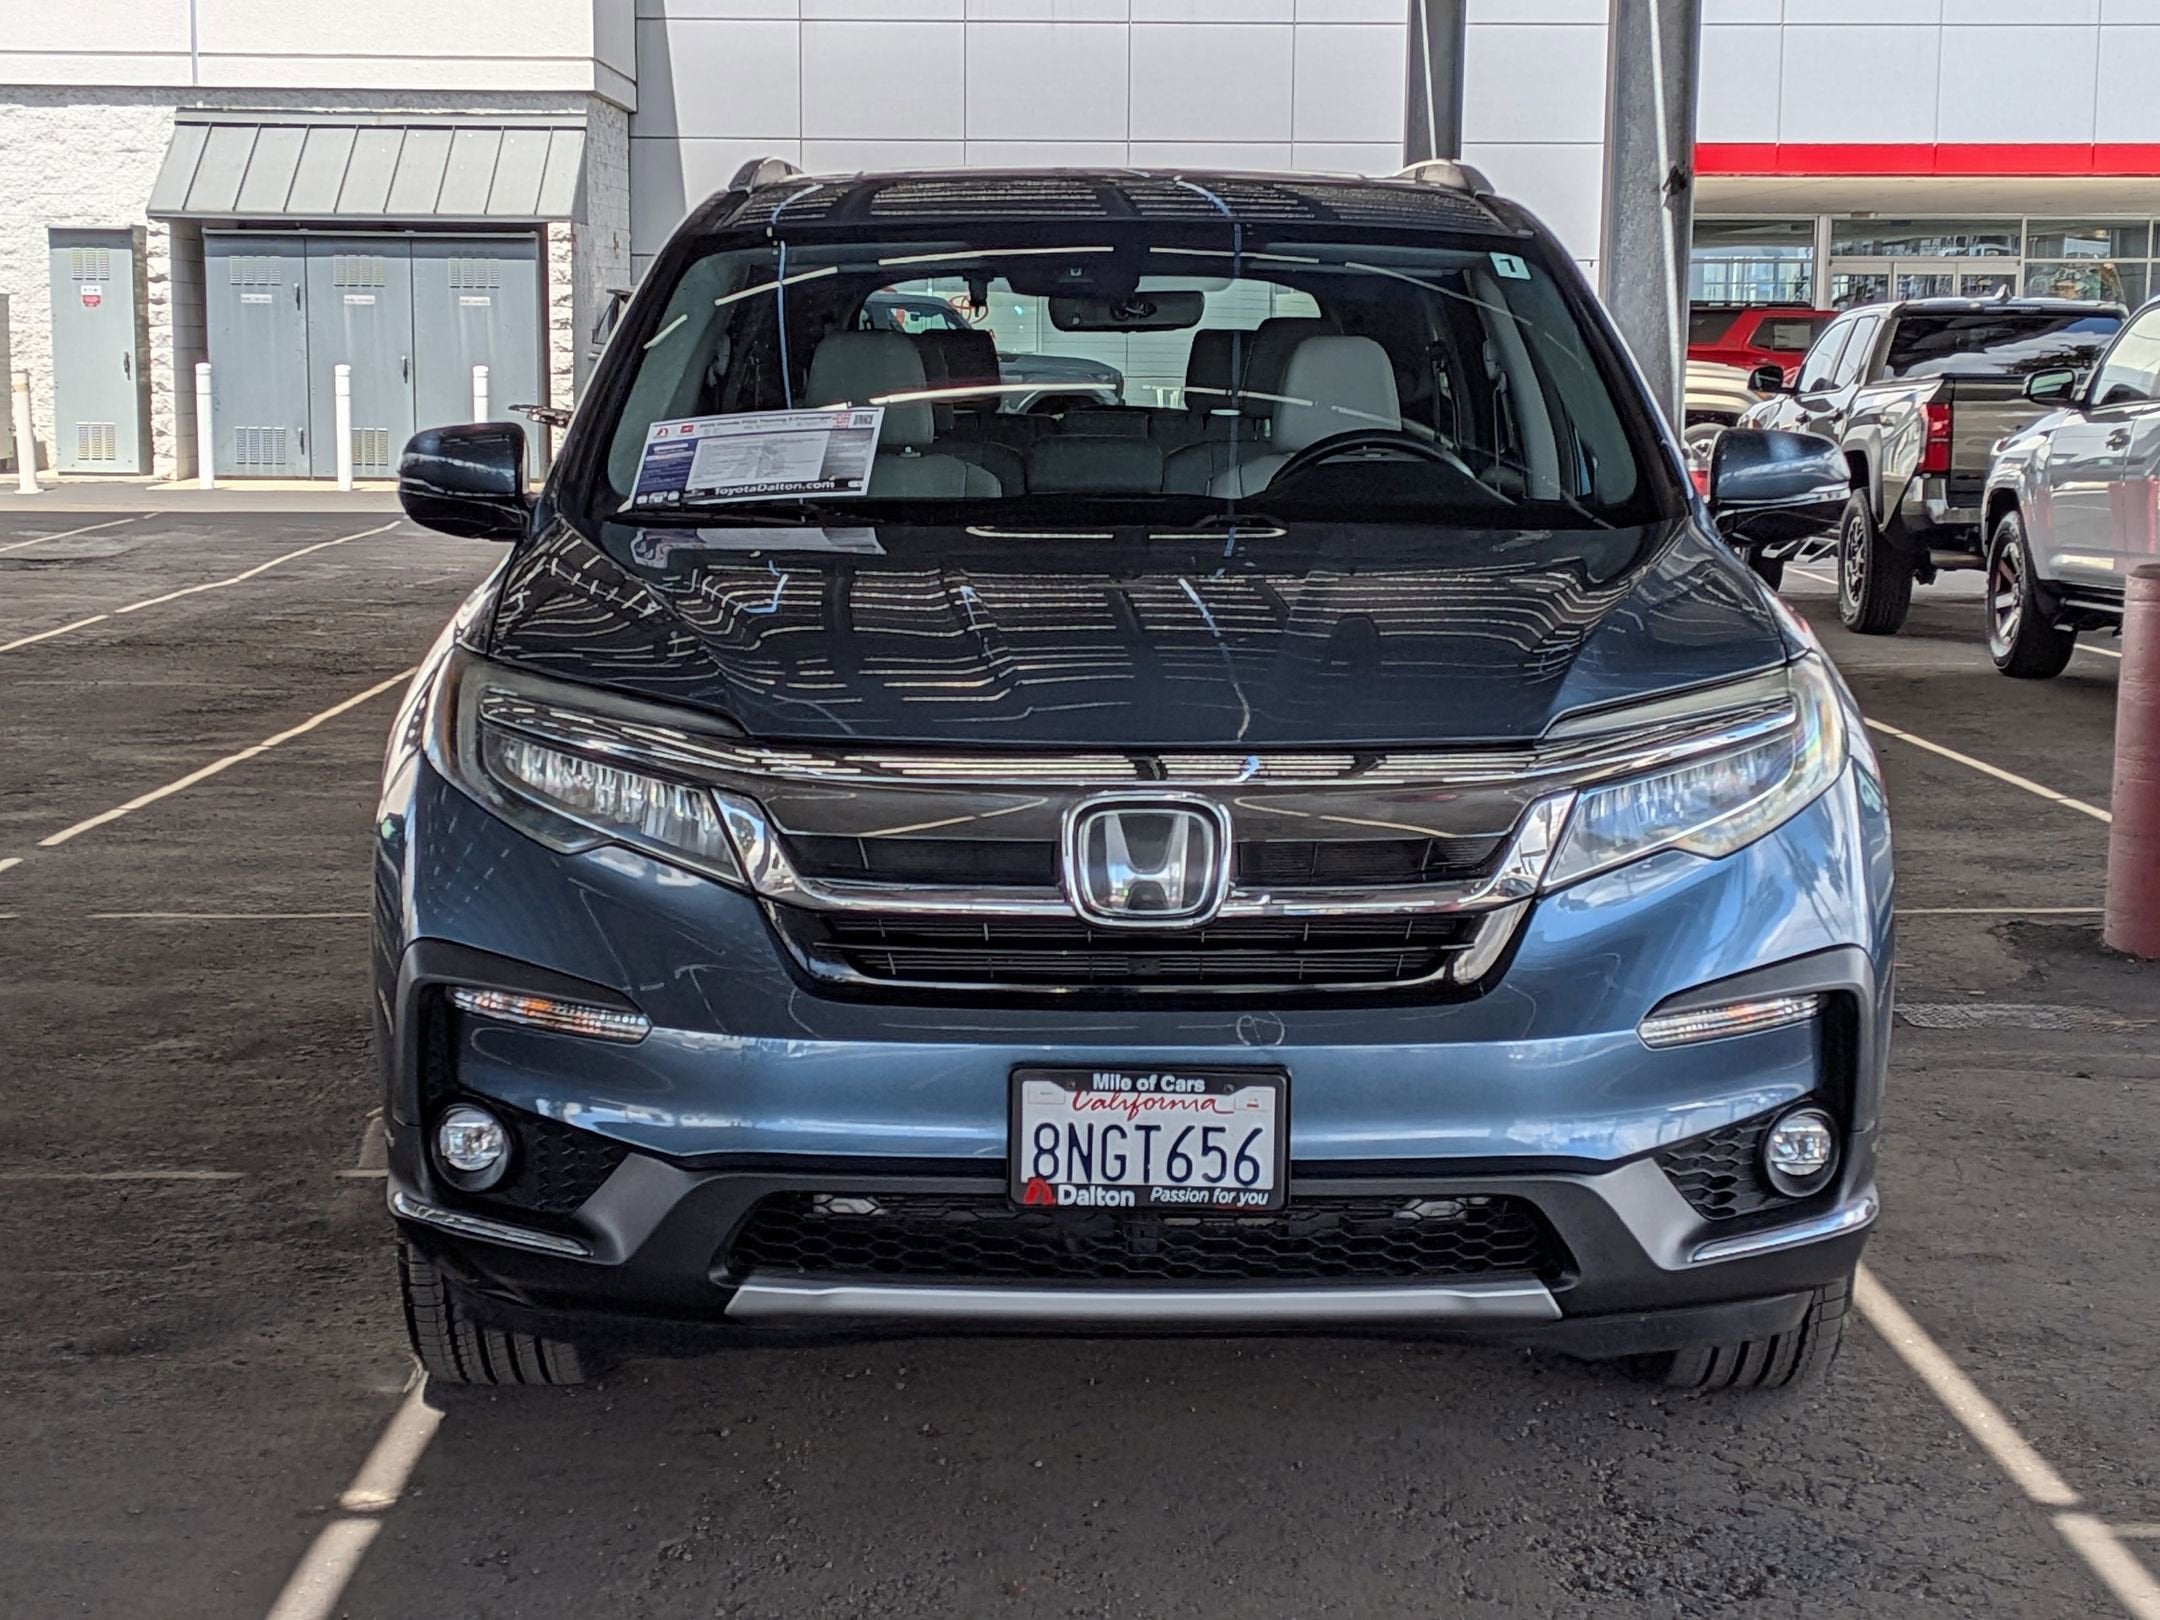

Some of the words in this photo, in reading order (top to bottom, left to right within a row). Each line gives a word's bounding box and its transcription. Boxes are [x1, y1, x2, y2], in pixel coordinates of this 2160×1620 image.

[714, 480, 835, 496] ToyotaDalton.com
[1092, 1072, 1132, 1091] Mile
[1135, 1074, 1158, 1091] of
[1160, 1075, 1206, 1093] Cars
[1071, 1089, 1234, 1121] California
[1033, 1121, 1264, 1186] 8NGT656
[1057, 1184, 1136, 1207] Dalton
[1149, 1186, 1210, 1203] Passion
[1212, 1188, 1237, 1204] for
[1237, 1191, 1269, 1207] you
